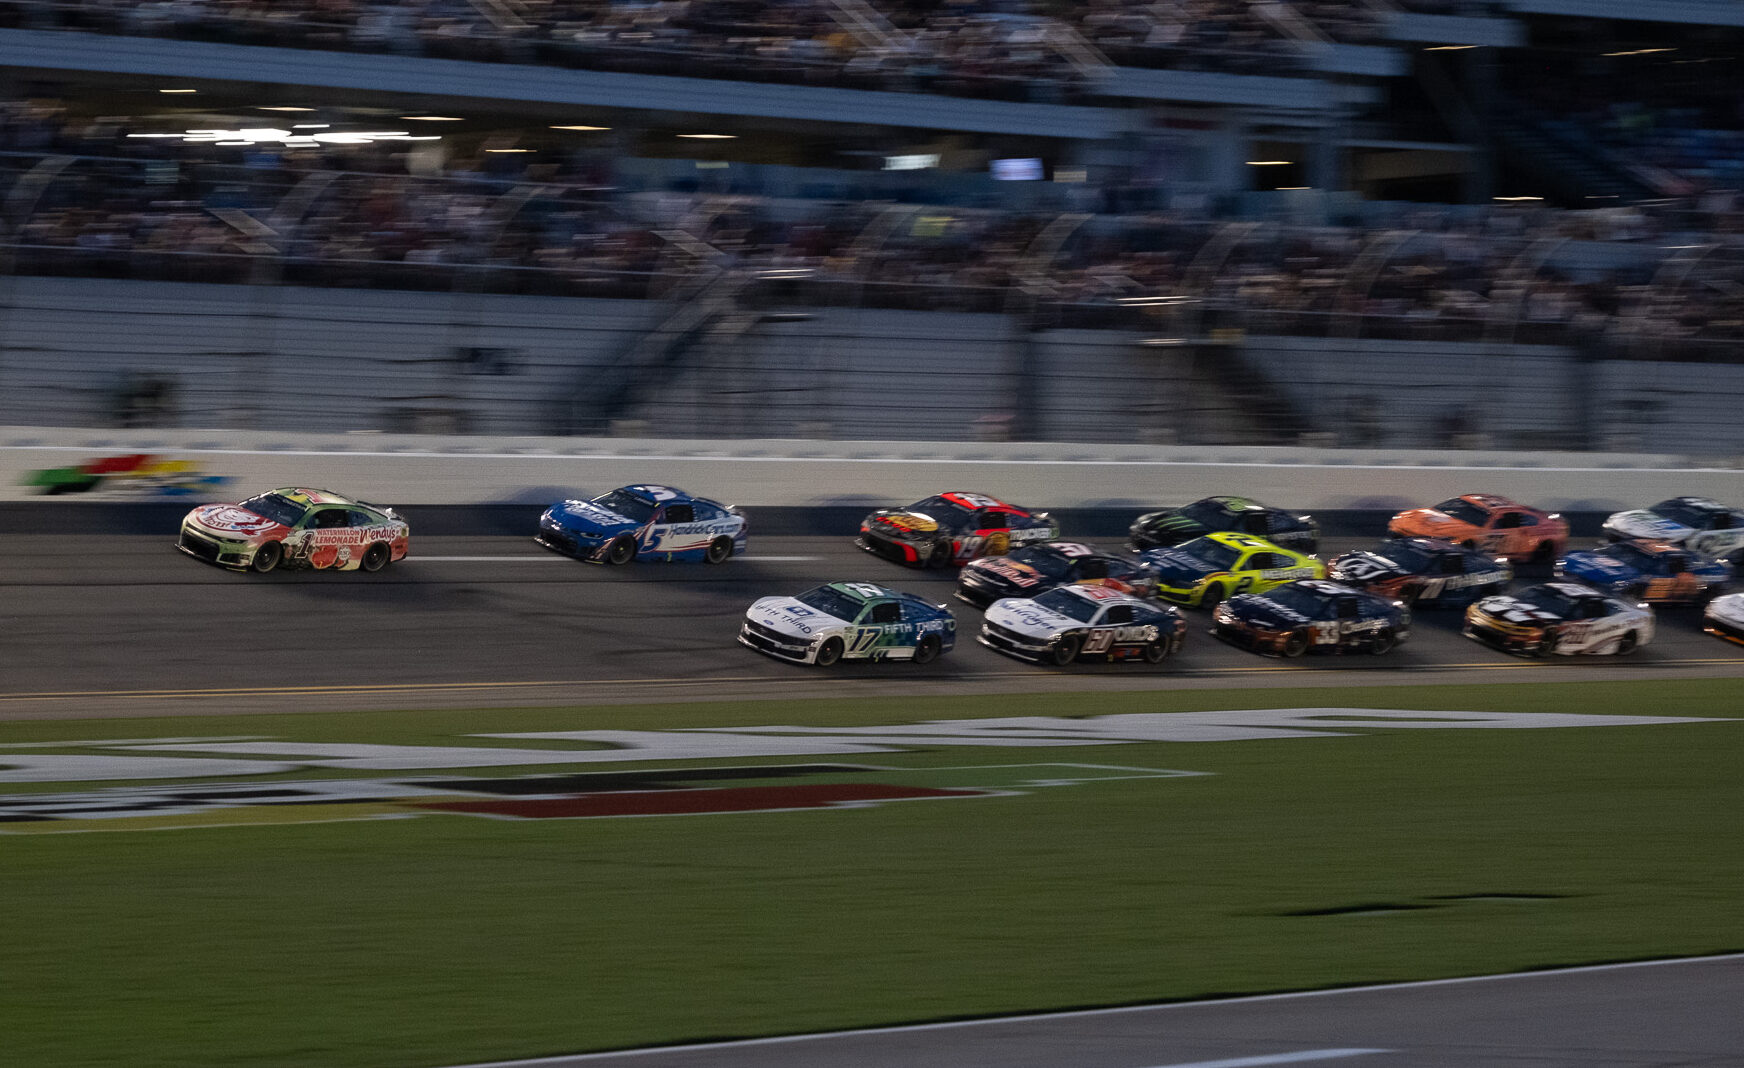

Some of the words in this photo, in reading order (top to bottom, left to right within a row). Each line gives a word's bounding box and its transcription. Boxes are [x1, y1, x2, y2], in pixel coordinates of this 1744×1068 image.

[315, 536, 359, 544] LEMONADE
[360, 525, 396, 544] Wendy's
[639, 528, 667, 553] 5
[295, 531, 315, 559] 1
[781, 614, 813, 634] THIRD
[884, 623, 913, 635] FIFTH
[915, 620, 944, 632] THIRD
[847, 626, 882, 653] 17
